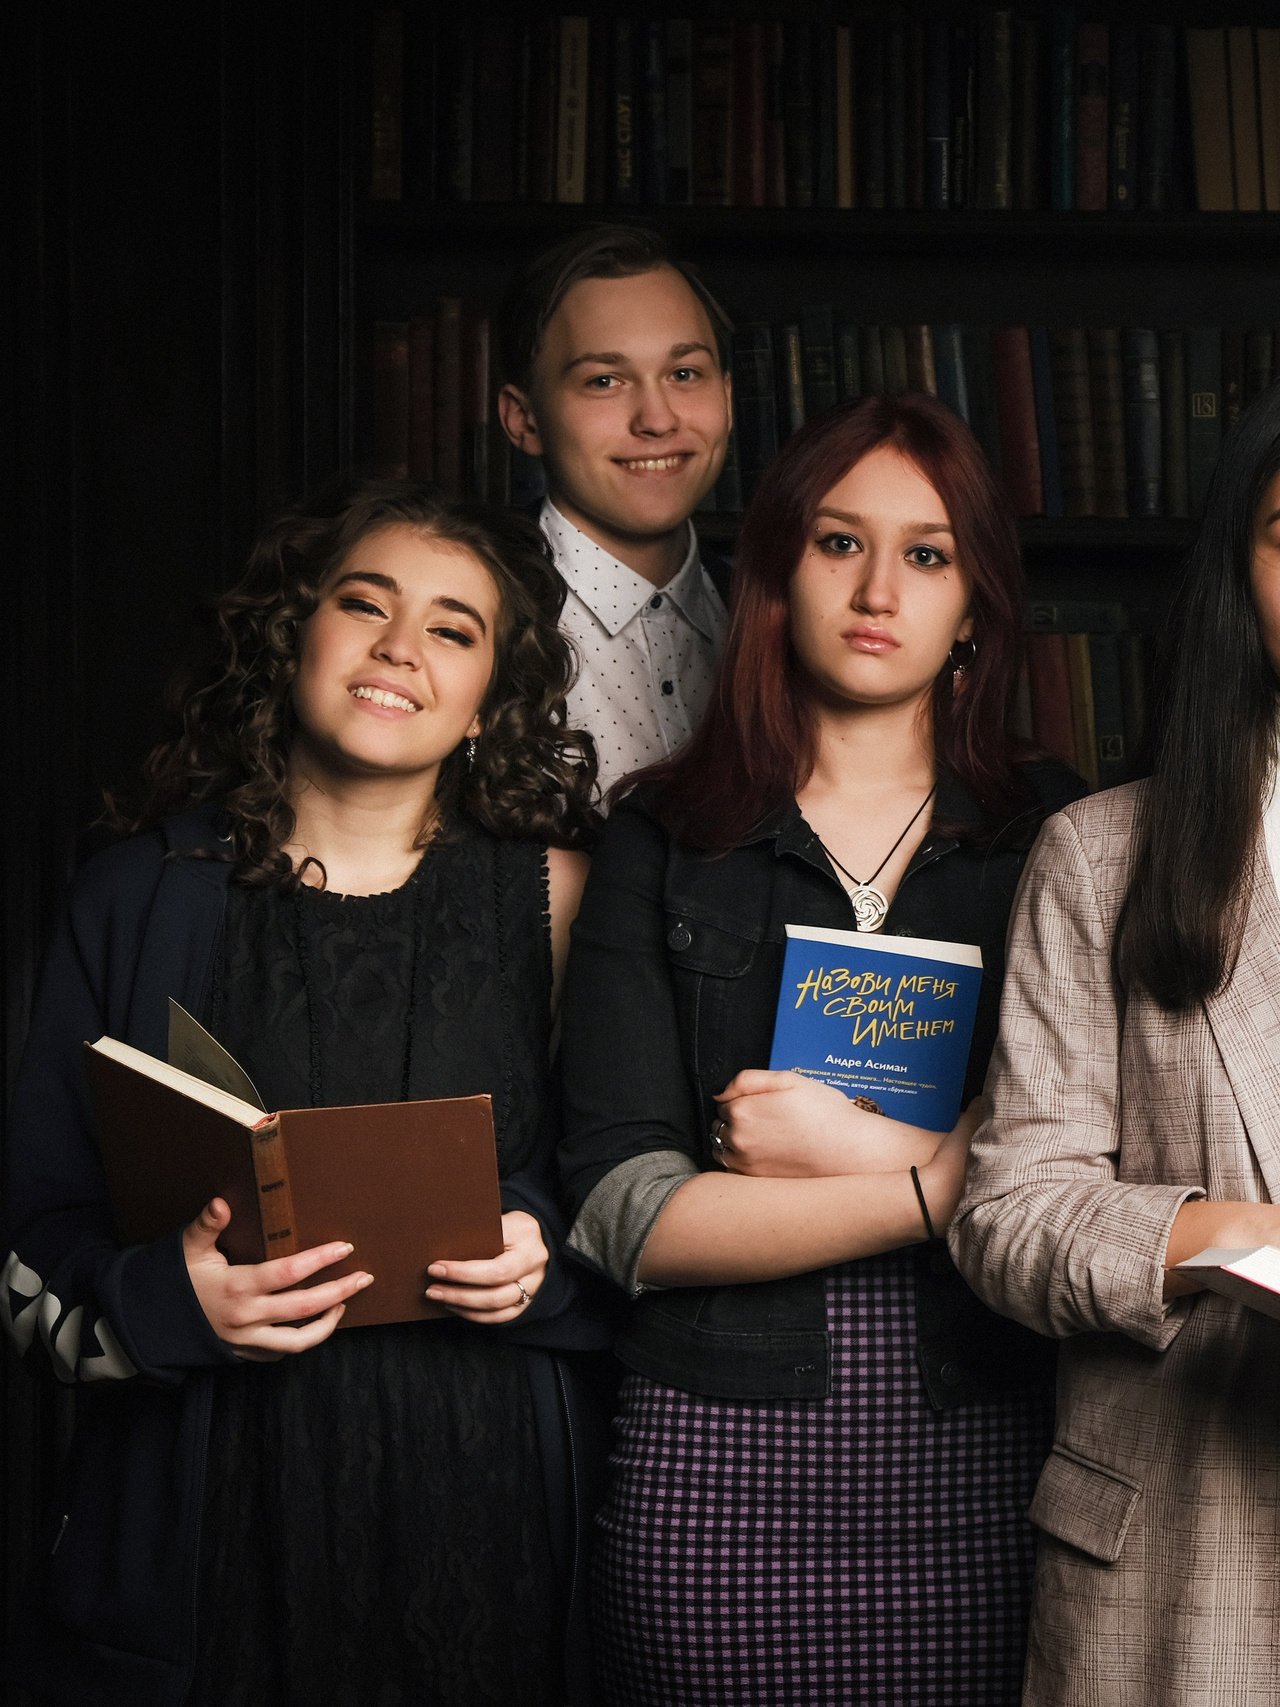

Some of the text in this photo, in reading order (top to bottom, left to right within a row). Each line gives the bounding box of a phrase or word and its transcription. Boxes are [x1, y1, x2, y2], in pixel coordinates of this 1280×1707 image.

[617, 92, 634, 144] СТАУТ
[1196, 396, 1212, 415] 18
[824, 1054, 908, 1073] Андре Асиман
[826, 1078, 850, 1088] Тойбин,
[887, 1086, 918, 1095] «Бруклин»
[883, 1077, 917, 1087] Настоящее
